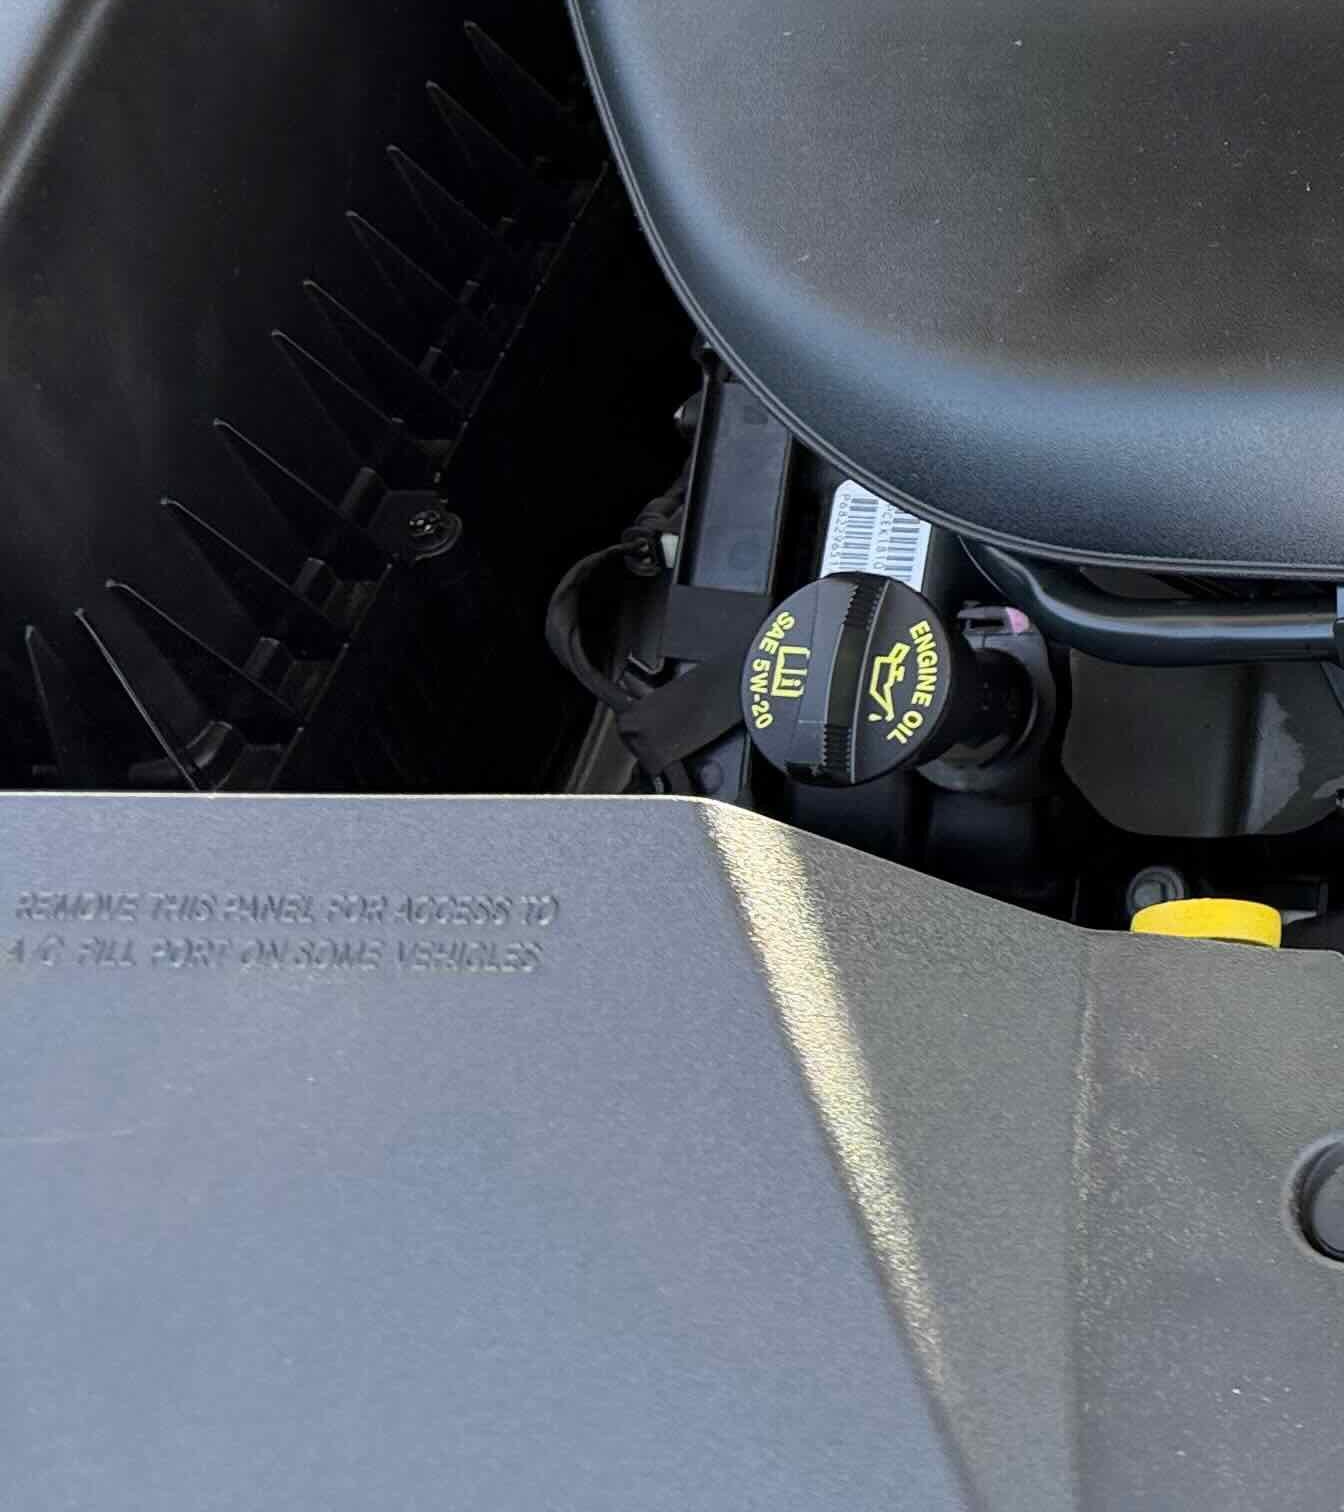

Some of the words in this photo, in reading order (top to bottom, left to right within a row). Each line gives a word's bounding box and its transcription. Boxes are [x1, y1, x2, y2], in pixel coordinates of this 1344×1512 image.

[759, 611, 795, 655] SAE
[909, 619, 938, 708] ENGINE
[749, 658, 774, 729] 5W-20
[886, 710, 923, 745] OIL
[16, 891, 140, 922] REMOVE
[149, 891, 218, 922] THIS
[223, 892, 316, 924] PANEL
[324, 893, 390, 925] FOR
[396, 894, 515, 926] ACCESS
[519, 894, 561, 927] TO
[75, 936, 137, 968] FILL
[149, 937, 233, 969] PORT
[240, 938, 290, 970] ON
[294, 938, 387, 972] SOME
[396, 939, 546, 974] VEHICLES
